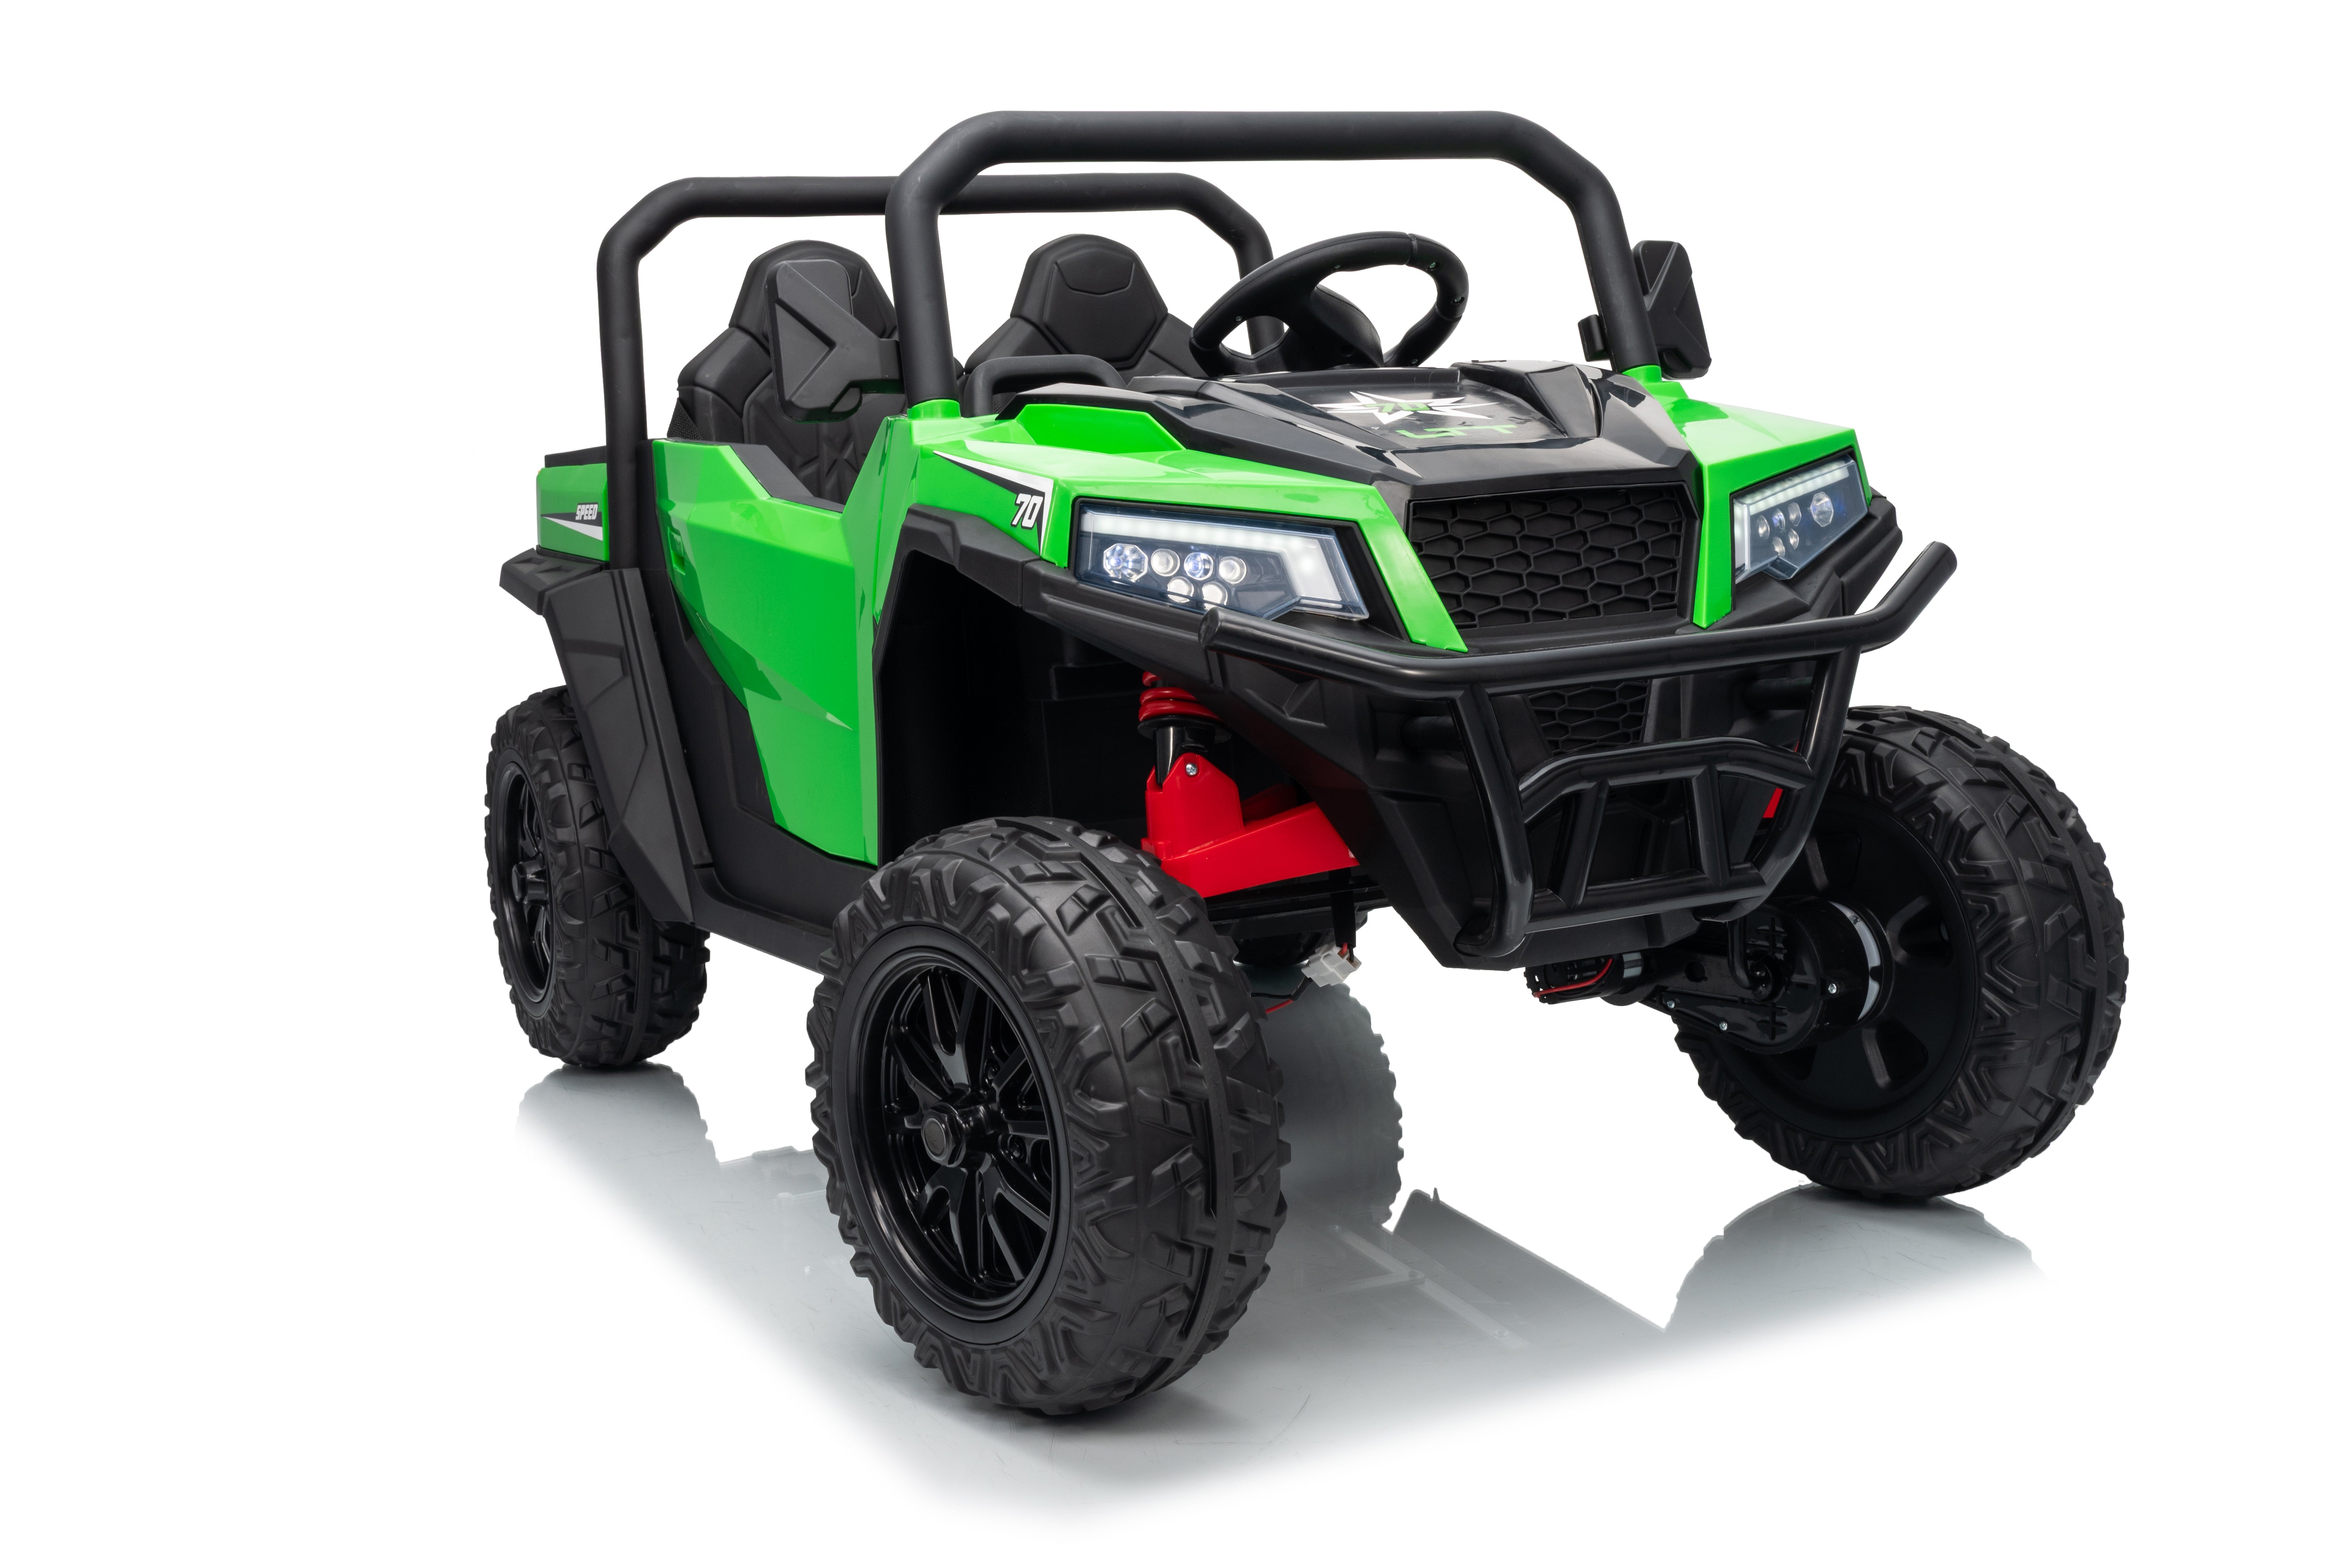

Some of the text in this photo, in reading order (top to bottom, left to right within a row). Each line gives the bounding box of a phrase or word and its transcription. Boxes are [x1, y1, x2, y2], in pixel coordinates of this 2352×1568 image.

[1365, 403, 1430, 412] 70
[575, 504, 598, 520] SPEED
[1012, 493, 1043, 528] 70
